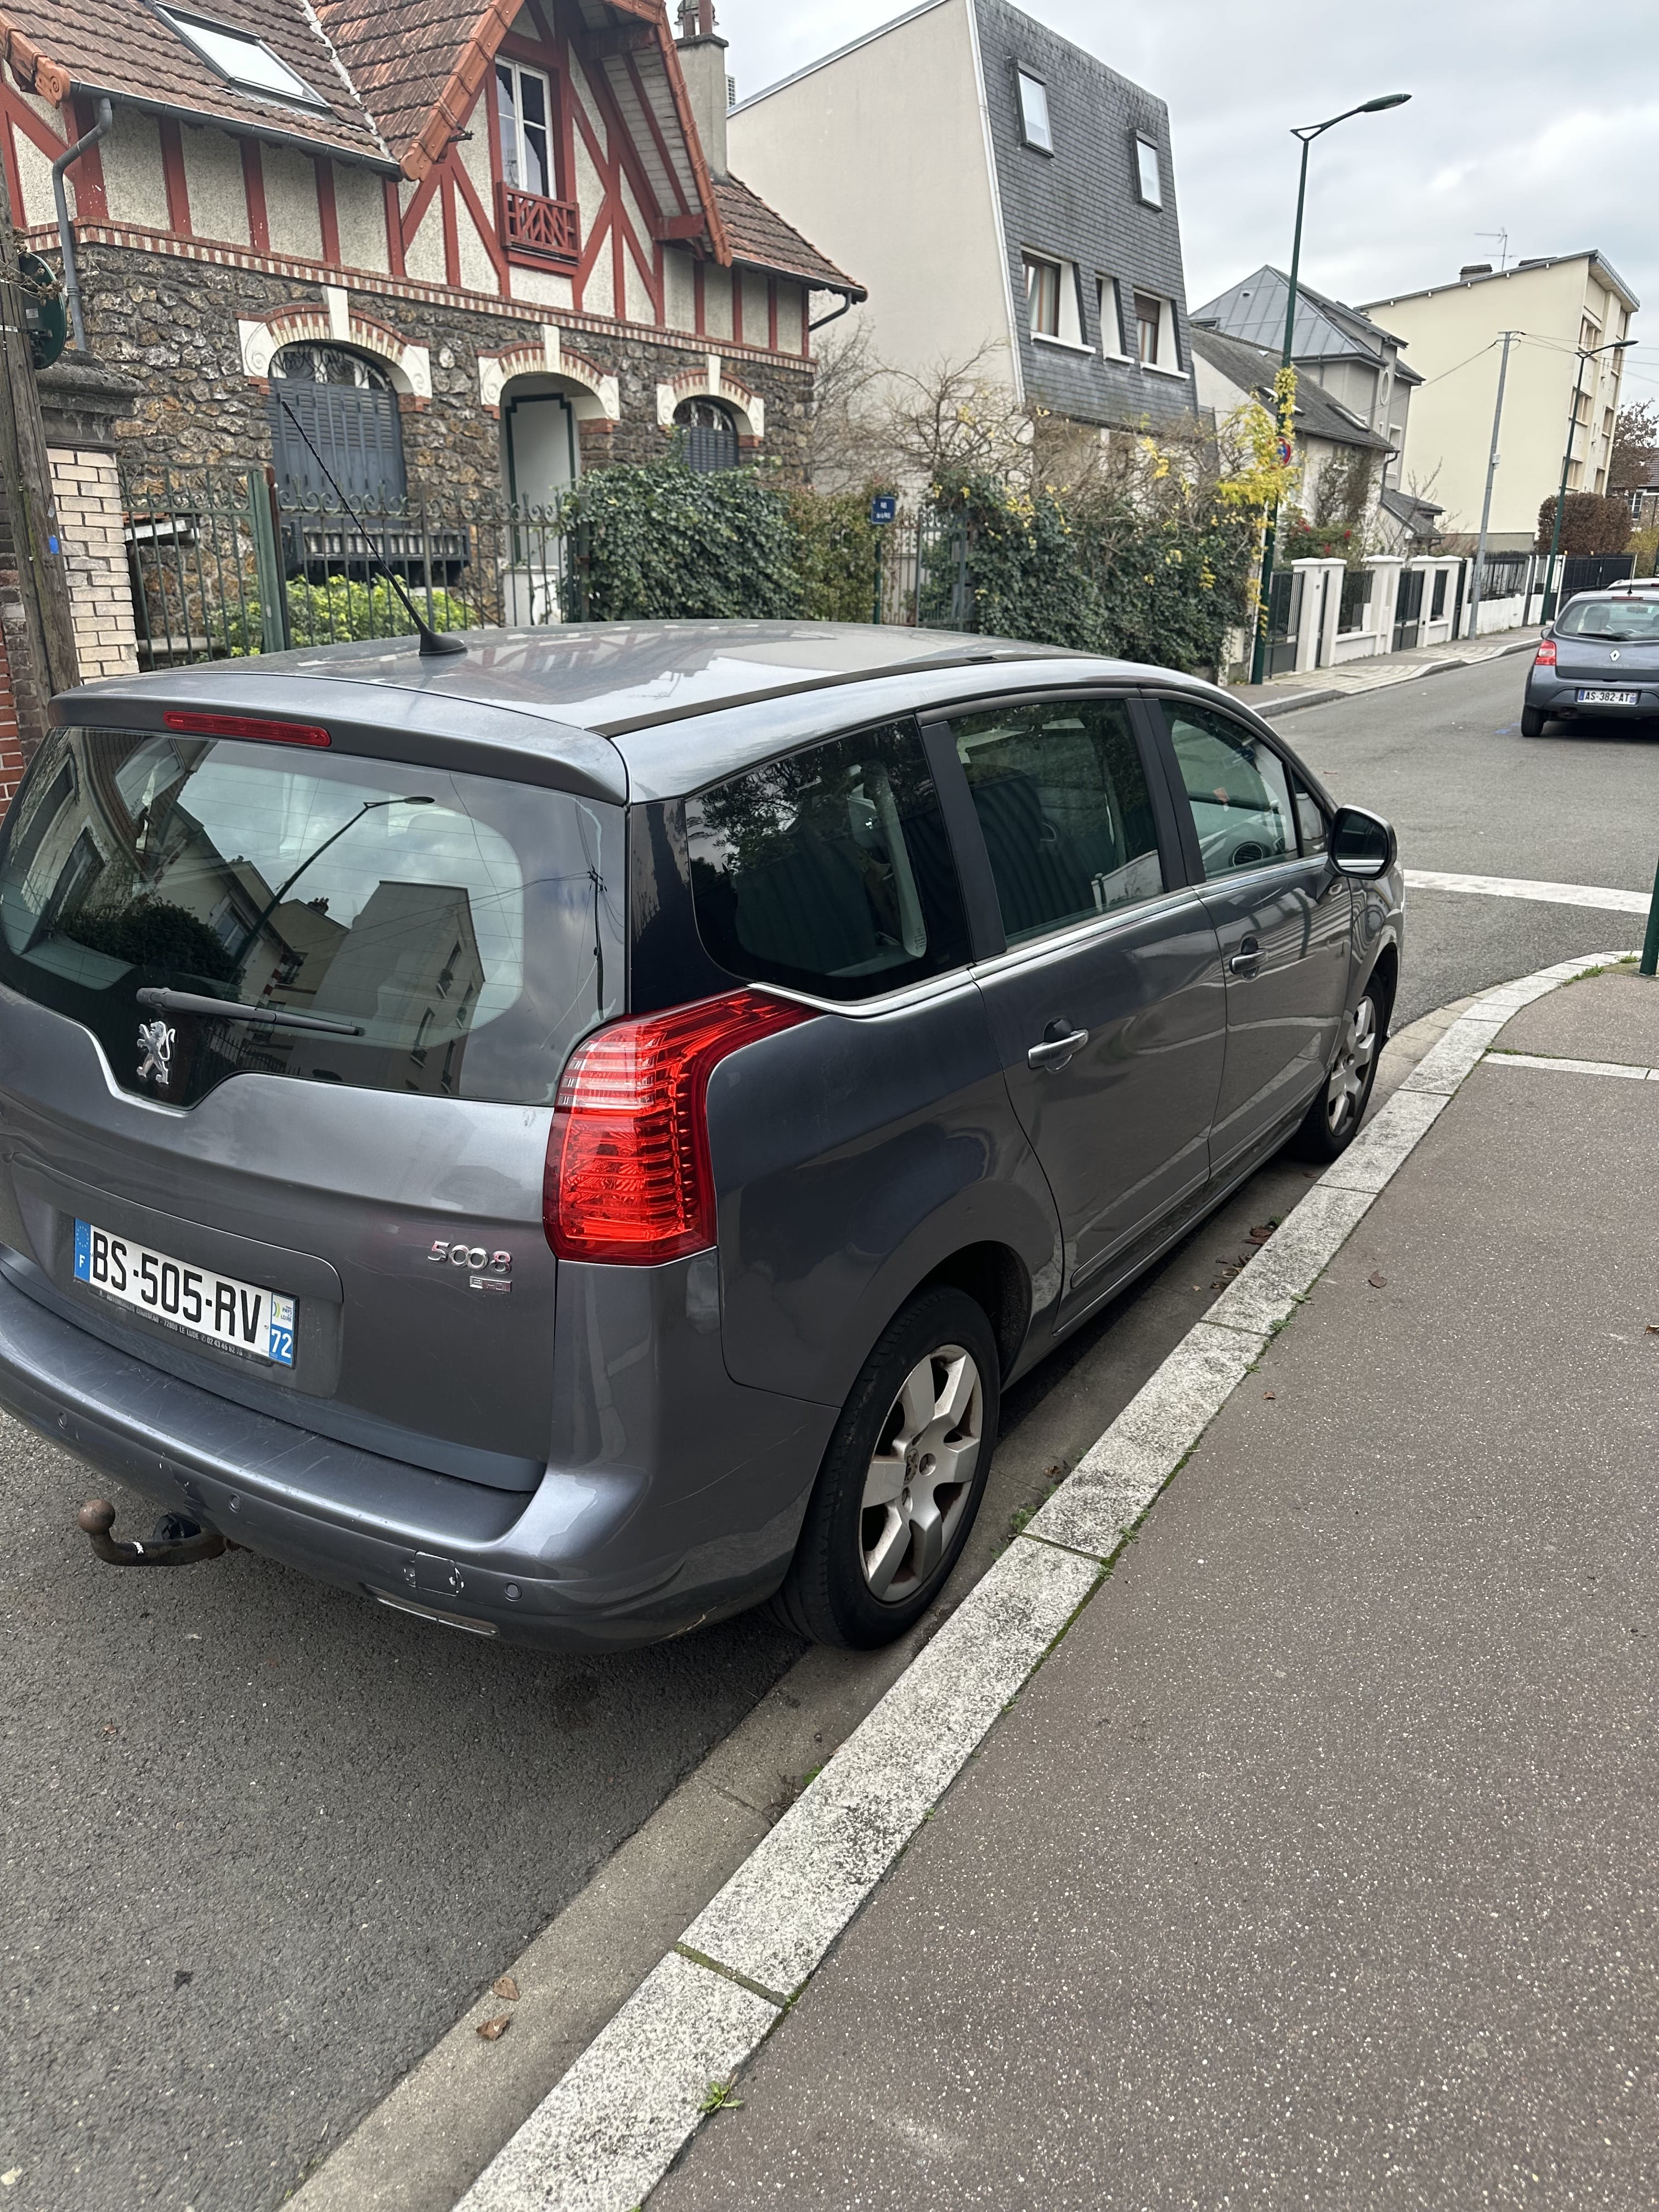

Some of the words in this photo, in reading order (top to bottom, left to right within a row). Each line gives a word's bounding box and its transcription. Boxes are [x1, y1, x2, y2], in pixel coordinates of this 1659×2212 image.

[1585, 691, 1630, 702] AS-382-AT
[79, 1254, 86, 1268] F
[427, 1240, 512, 1274] 5008
[93, 1231, 262, 1344] BS-505-RV
[179, 1325, 185, 1334] LE
[187, 1328, 199, 1340] LUDE
[271, 1328, 292, 1358] 72
